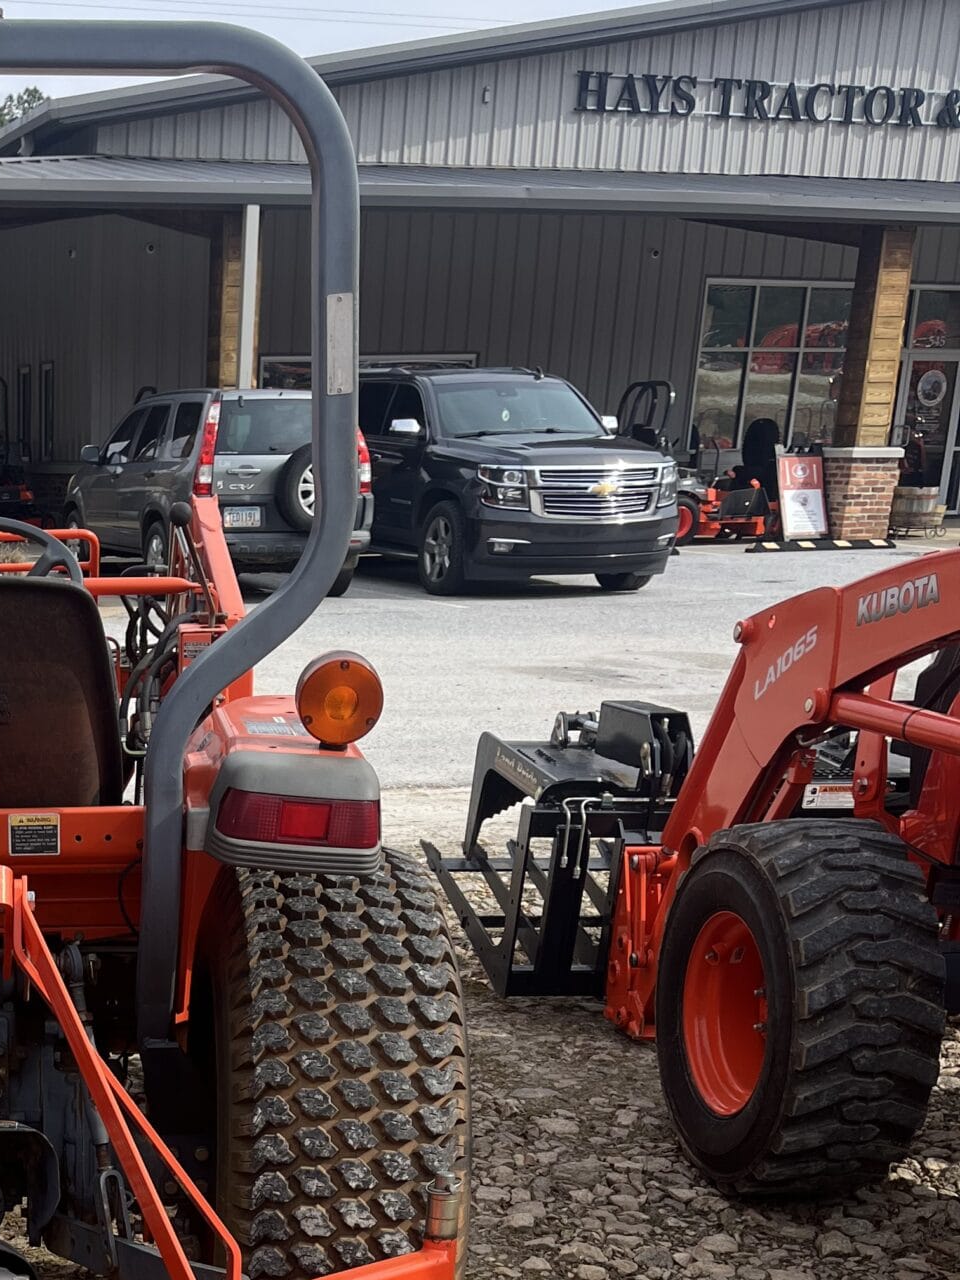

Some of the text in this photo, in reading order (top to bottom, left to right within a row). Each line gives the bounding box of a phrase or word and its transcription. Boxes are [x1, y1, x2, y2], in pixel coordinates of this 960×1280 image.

[574, 70, 960, 129] HAYS TRACTOR &
[856, 573, 939, 627] KUBOTA
[754, 625, 818, 701] LA1065
